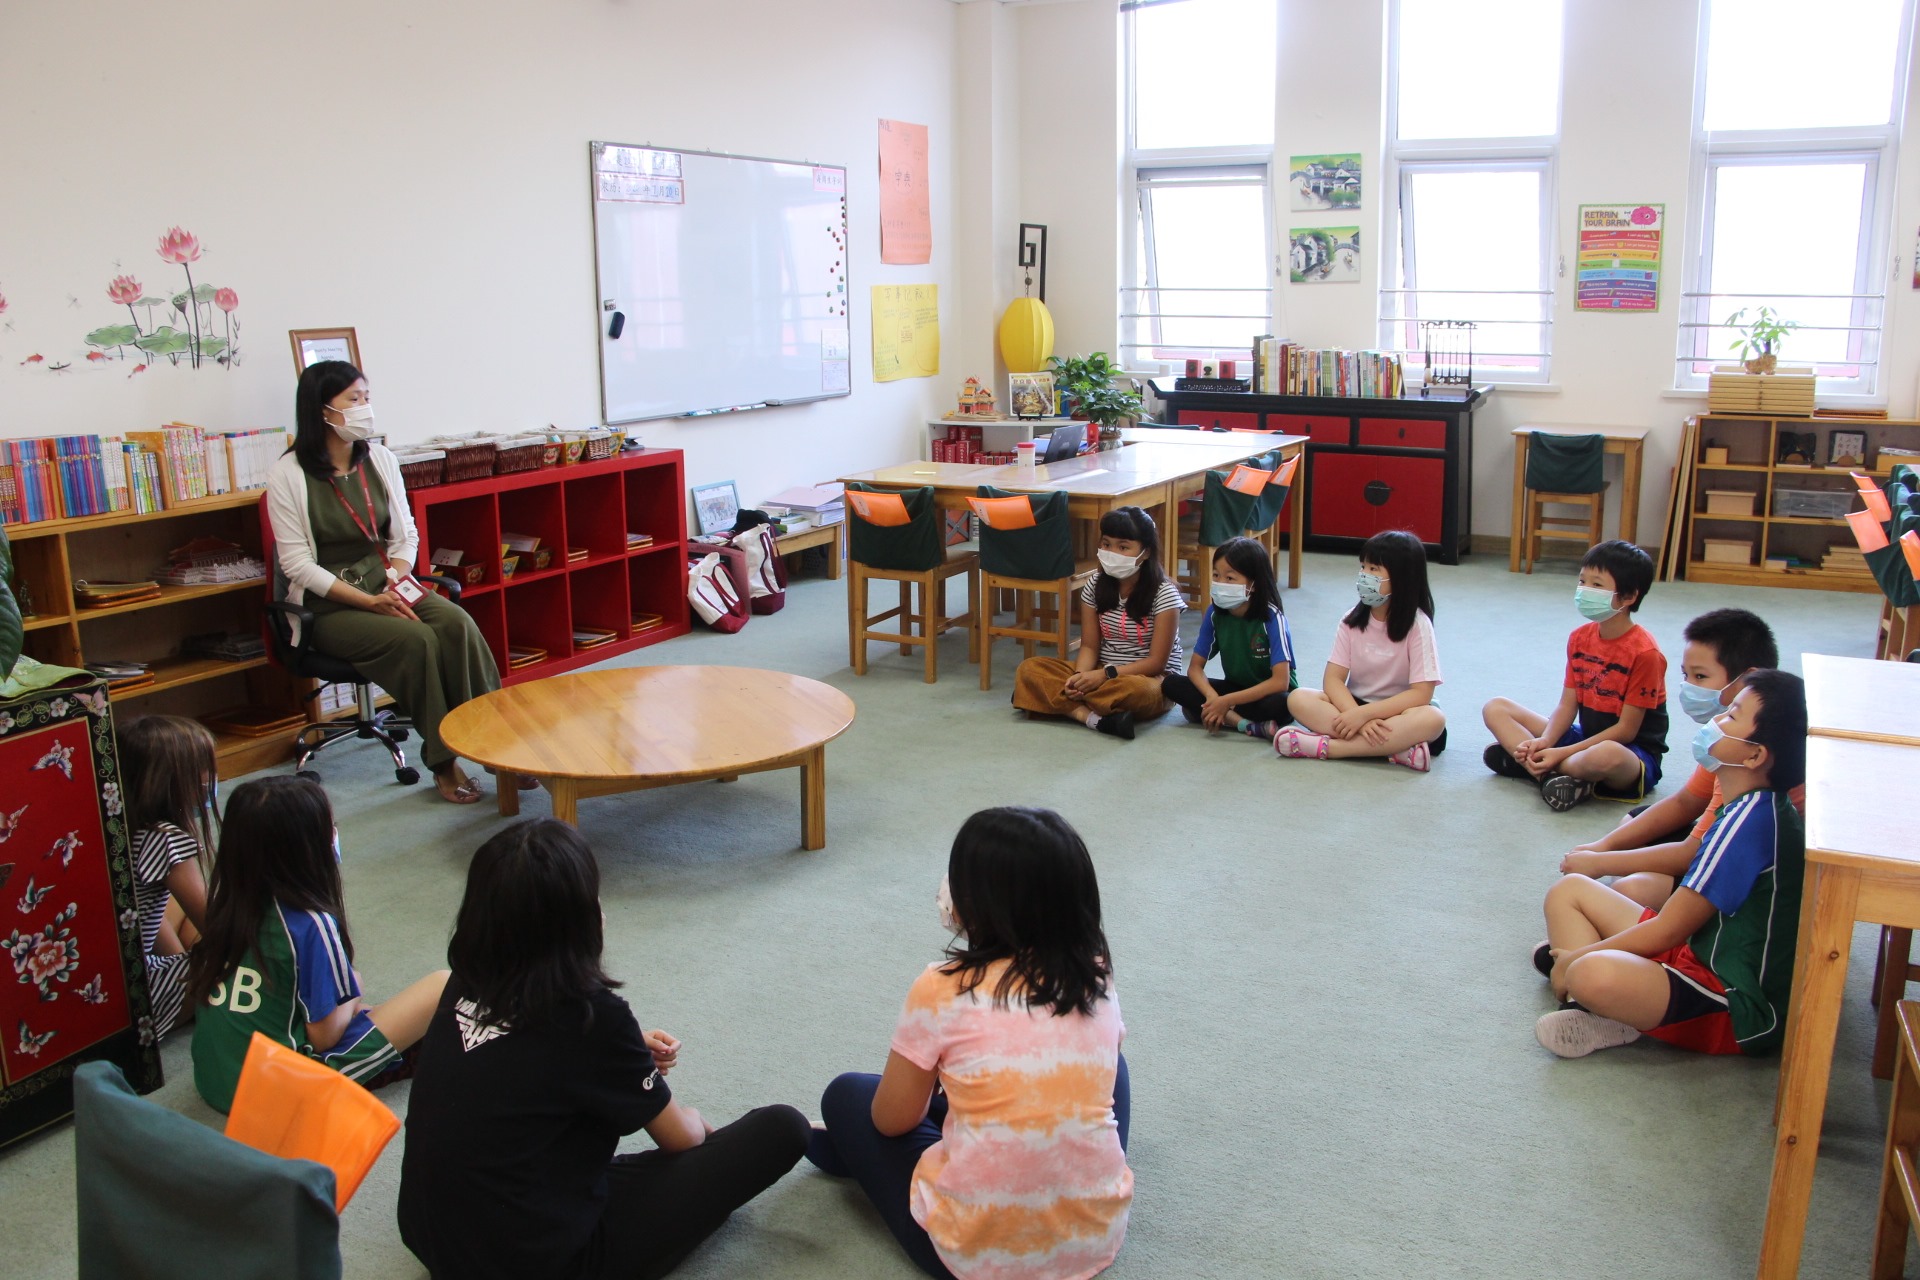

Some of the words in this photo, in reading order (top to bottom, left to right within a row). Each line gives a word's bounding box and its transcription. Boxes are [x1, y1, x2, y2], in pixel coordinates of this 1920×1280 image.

[1584, 211, 1618, 219] RETRAIN
[1584, 219, 1603, 227] YOUR
[1606, 219, 1631, 227] BRAIN
